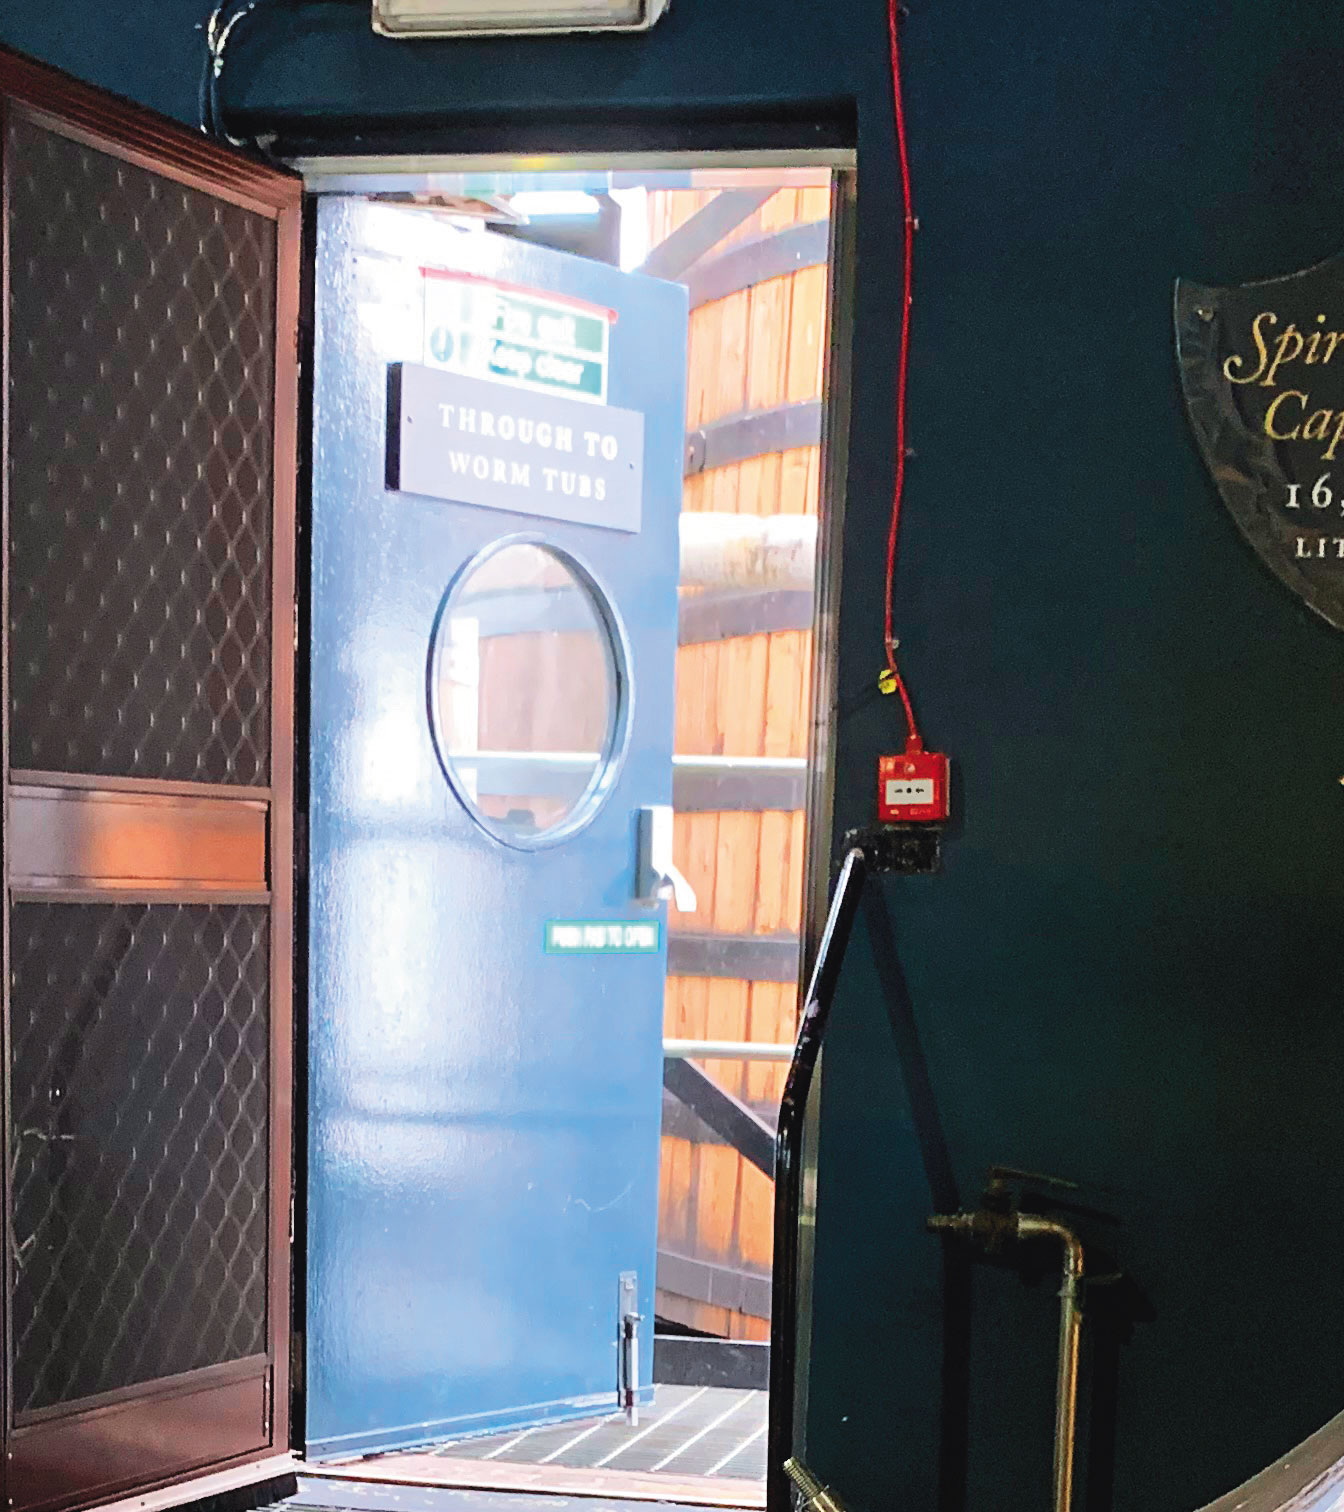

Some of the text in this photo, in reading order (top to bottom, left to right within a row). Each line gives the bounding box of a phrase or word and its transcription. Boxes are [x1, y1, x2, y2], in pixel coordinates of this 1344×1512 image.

[438, 403, 618, 461] THROUGH TO
[448, 450, 606, 501] WORM TUBS
